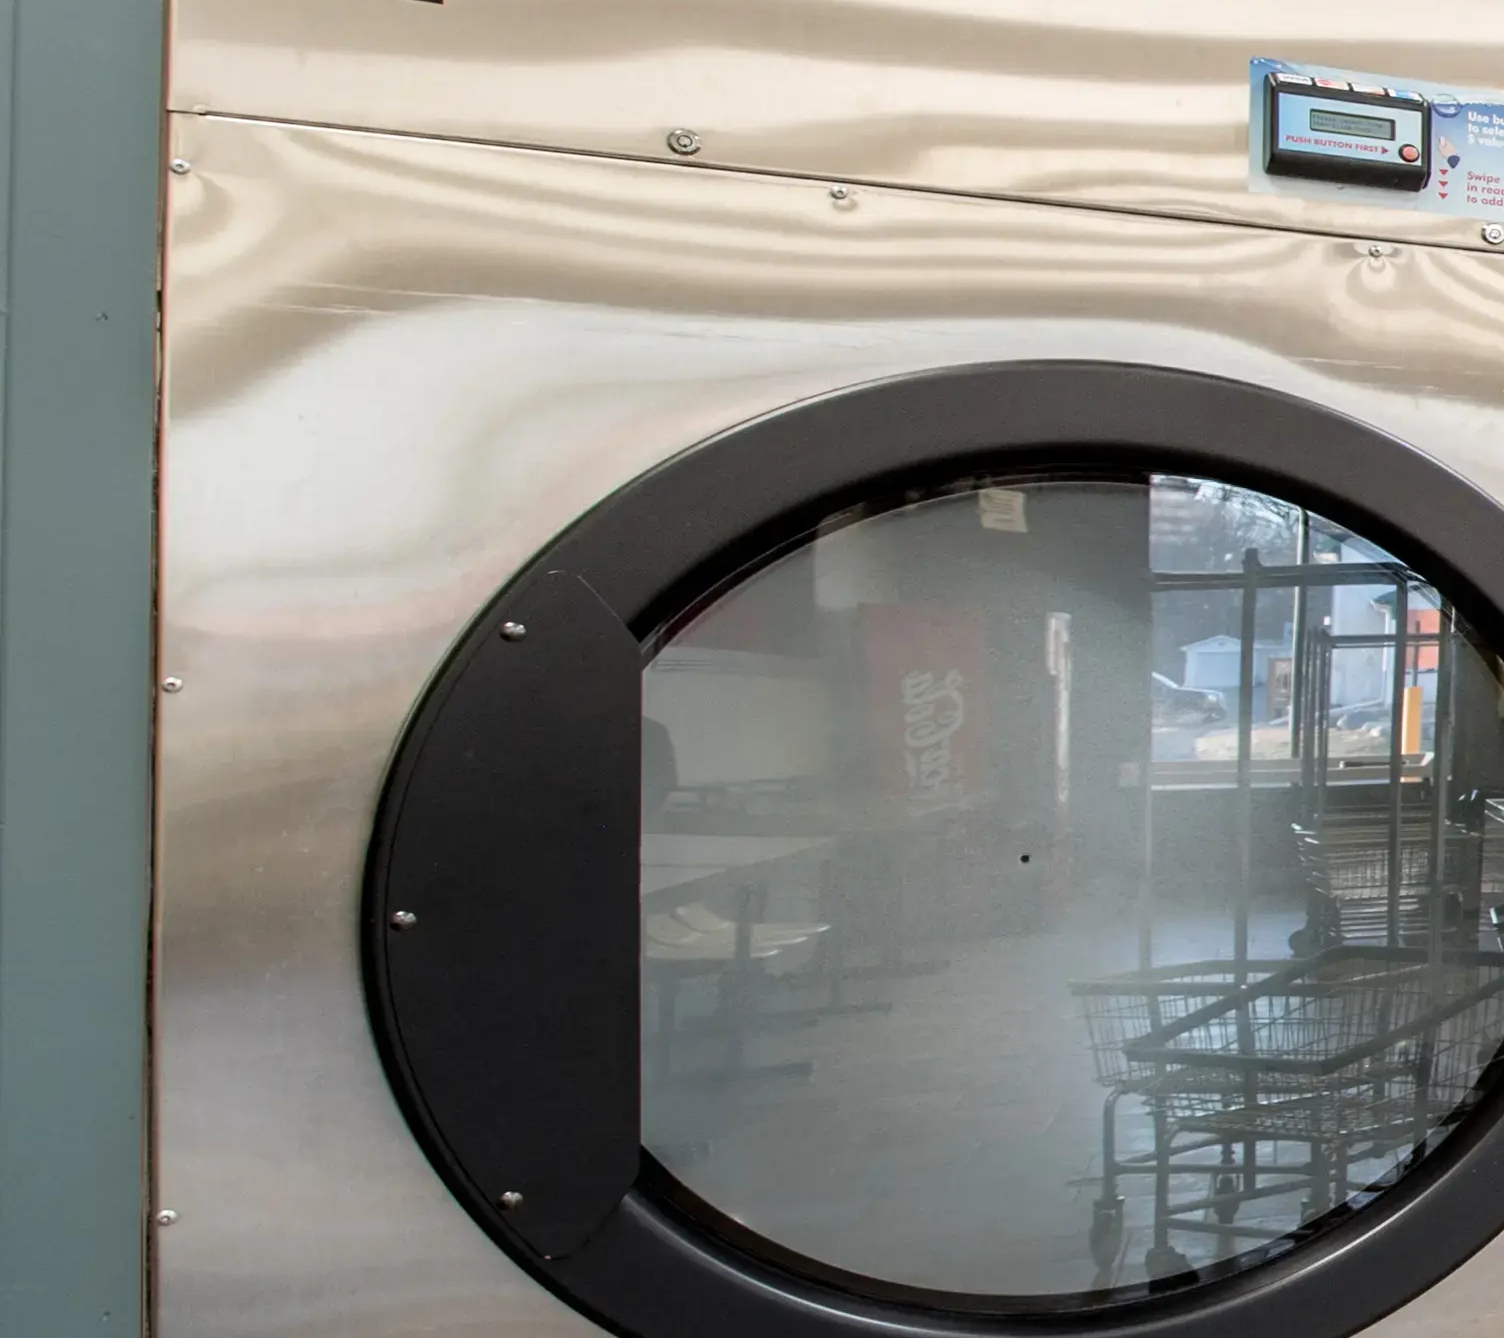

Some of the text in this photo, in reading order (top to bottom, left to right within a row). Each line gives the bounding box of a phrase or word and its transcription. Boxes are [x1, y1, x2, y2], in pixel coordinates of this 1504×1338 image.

[1468, 111, 1490, 124] Use
[1468, 123, 1479, 133] to
[1285, 134, 1380, 153] PUSH BUTTON FIRST
[1467, 171, 1501, 184] Swipe
[1467, 183, 1478, 192] in
[1467, 195, 1477, 204] to
[1481, 197, 1504, 207] add
